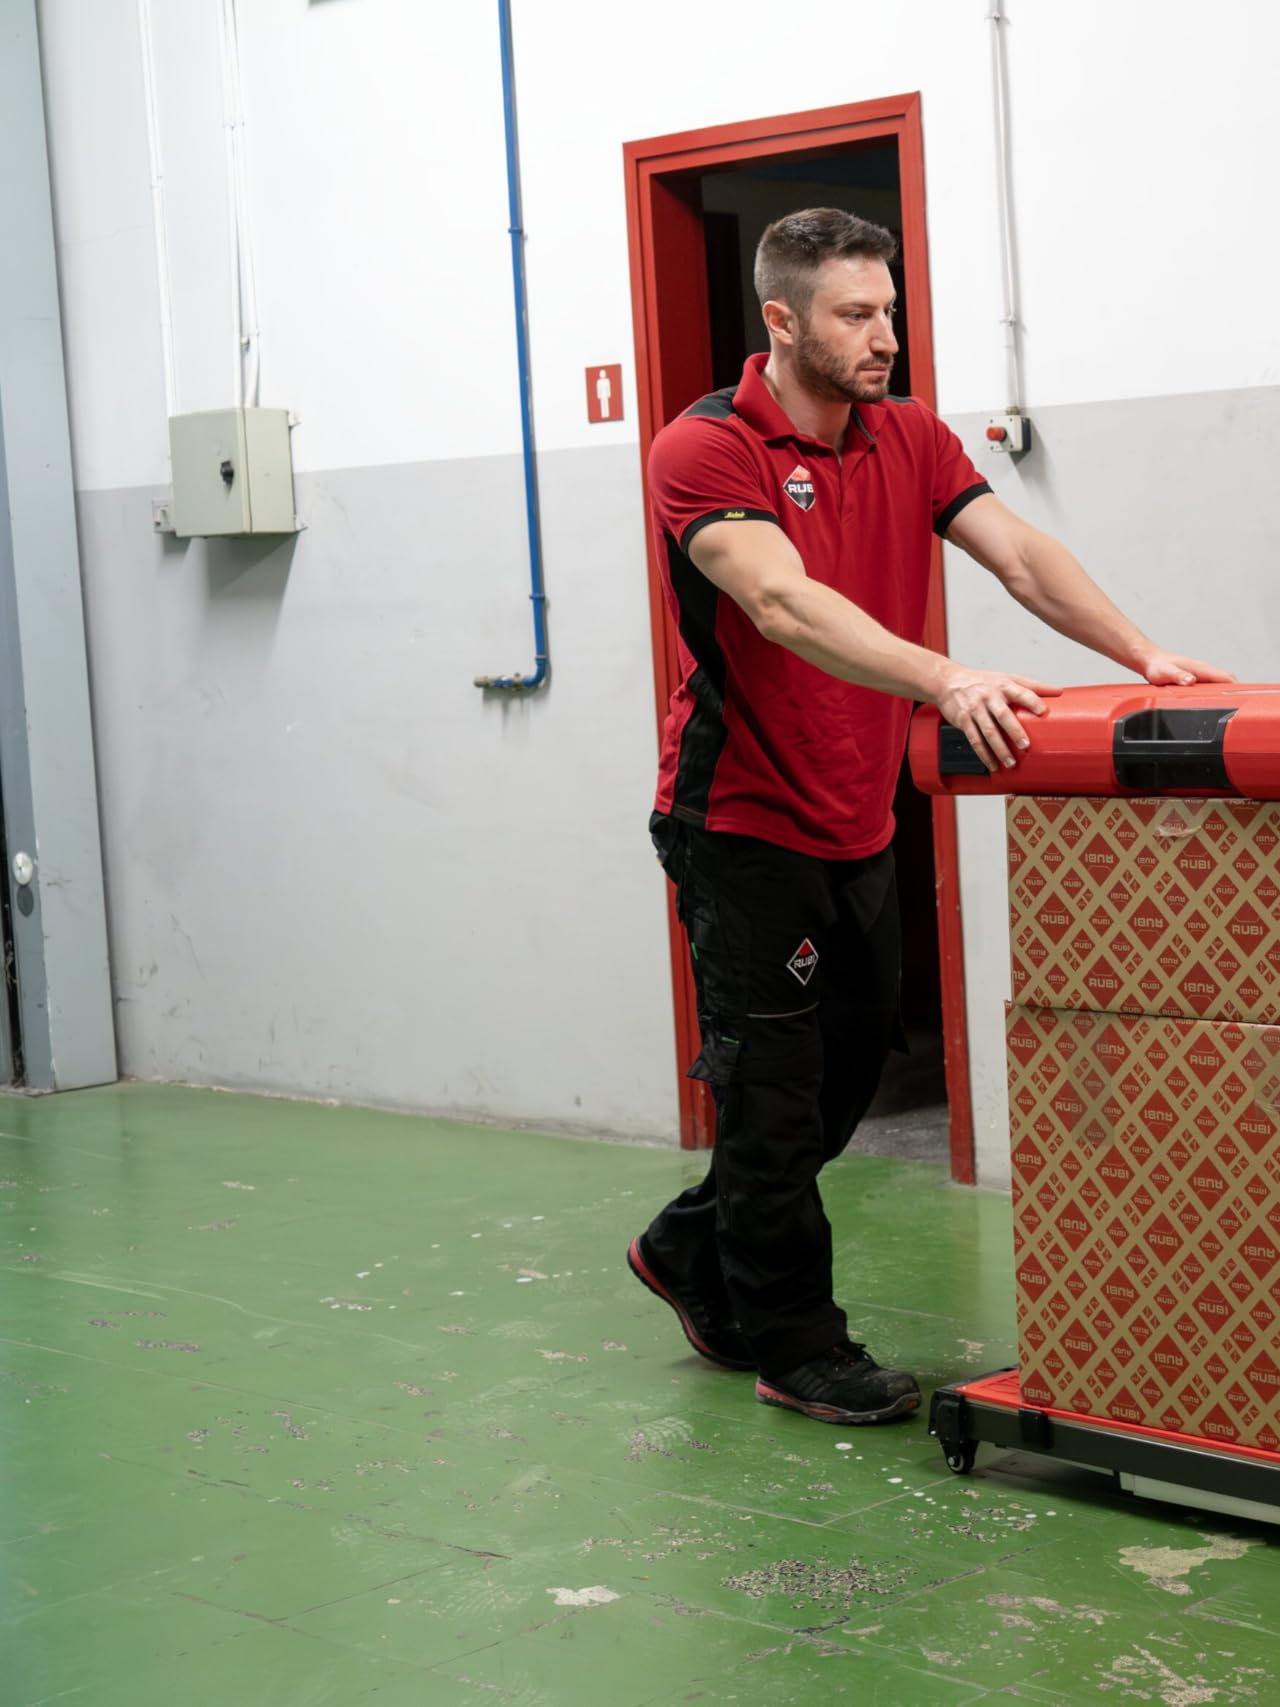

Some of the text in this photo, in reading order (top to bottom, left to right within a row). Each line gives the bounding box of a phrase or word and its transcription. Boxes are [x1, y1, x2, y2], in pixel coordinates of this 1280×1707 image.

[788, 483, 814, 493] RUB
[1085, 854, 1113, 864] RUBI
[1180, 859, 1211, 869] RUBI
[1040, 914, 1069, 924] RUBI
[1134, 917, 1163, 928] RUBI
[1232, 924, 1263, 935] RUBI
[1088, 978, 1118, 988] RUBI
[1184, 982, 1214, 993] RUBI
[1010, 1038, 1036, 1048] RUBI
[1097, 1044, 1125, 1055] RUBI
[1190, 1055, 1220, 1066] RUBI
[1056, 1102, 1081, 1112] RUBI
[1144, 1110, 1173, 1121] RUBI
[1240, 1123, 1270, 1134] RUBI
[1016, 1154, 1040, 1164] RUBI
[1102, 1168, 1129, 1178] RUBI
[1194, 1178, 1222, 1188] RUBI
[1060, 1219, 1087, 1230] RUBI
[1148, 1235, 1178, 1246] RUBI
[1244, 1246, 1275, 1258] RUBI
[1020, 1274, 1046, 1284] RUBI
[1106, 1286, 1134, 1296] RUBI
[1198, 1303, 1228, 1314] RUBI
[1066, 1340, 1092, 1350] RUBI
[1154, 1354, 1184, 1364] RUBI
[1250, 1372, 1280, 1384] RUBI
[1024, 1387, 1051, 1400] RUBI
[1112, 1407, 1139, 1420] RUBI
[1204, 1422, 1234, 1435] RUBI
